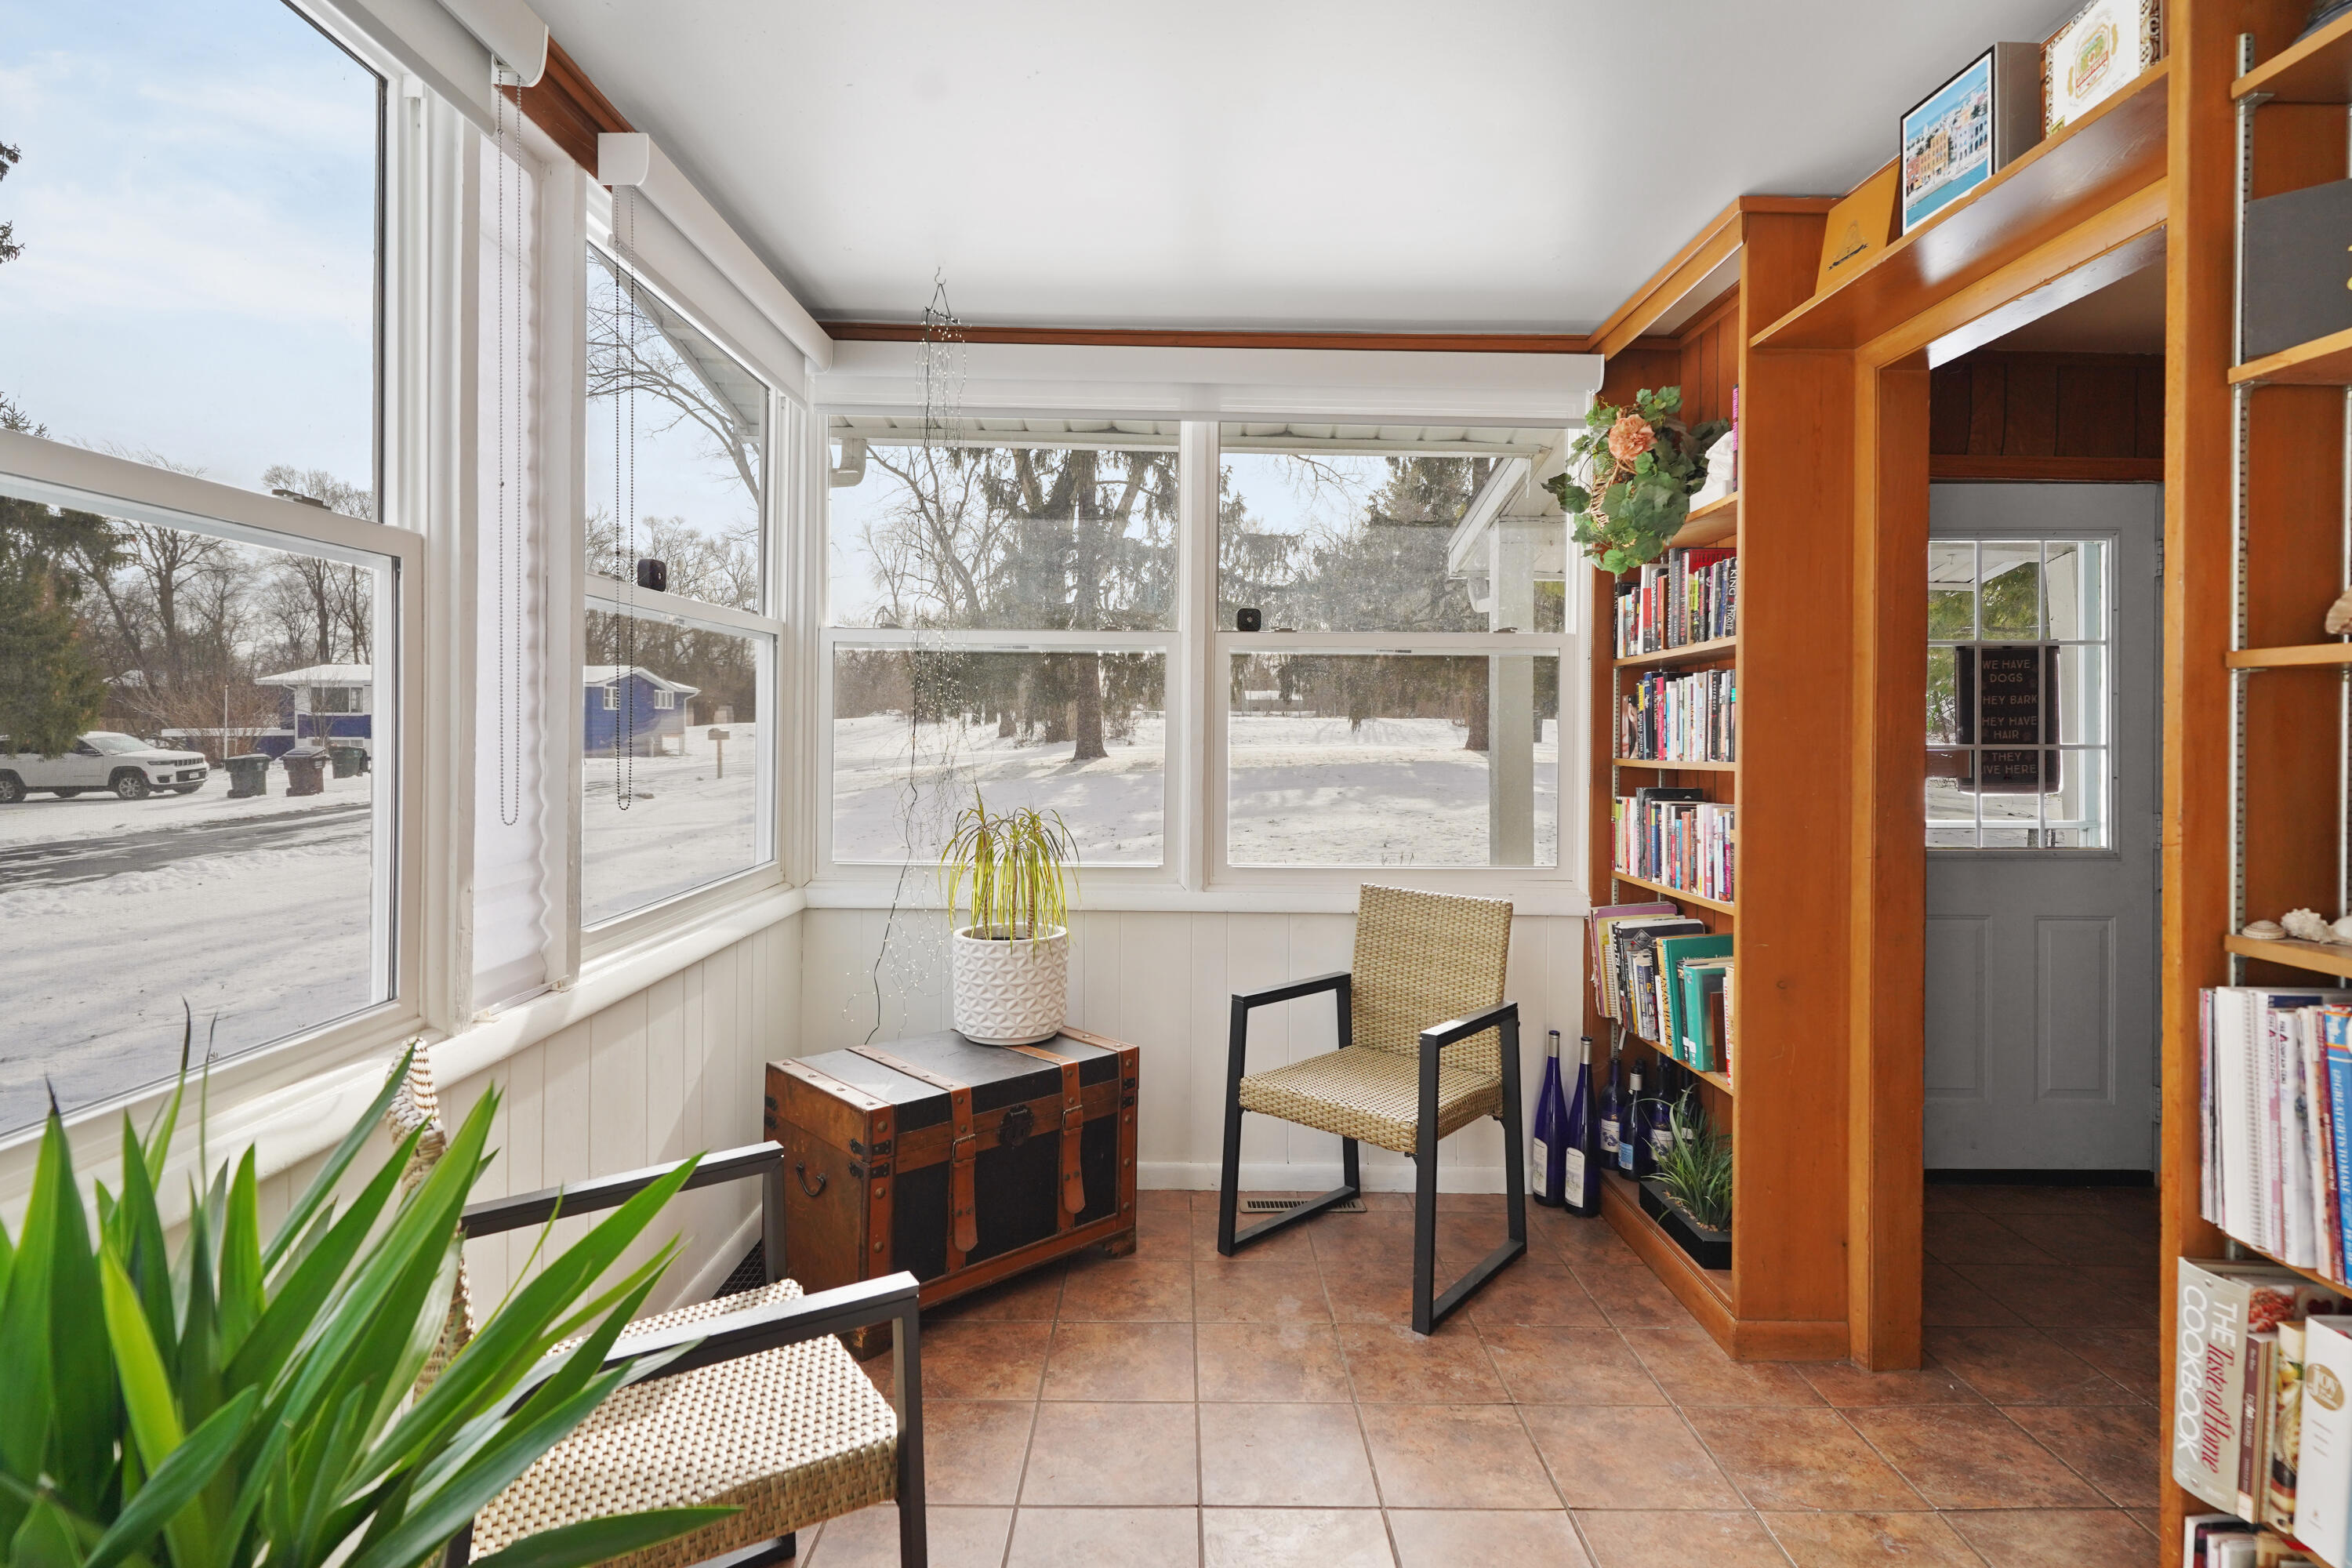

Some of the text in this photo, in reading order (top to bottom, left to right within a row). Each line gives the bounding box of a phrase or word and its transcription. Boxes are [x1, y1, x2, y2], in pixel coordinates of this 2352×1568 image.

[1729, 569, 1737, 596] KING
[1982, 659, 2031, 670] WE HAVE
[1989, 673, 2024, 683] DOGS
[1982, 695, 2038, 705] HEY BARK
[1981, 716, 2038, 727] HEY HAVE
[1994, 730, 2020, 739] HAIR
[1991, 753, 2022, 761] THEY
[1981, 764, 2038, 775] IVE HERE
[2211, 1300, 2238, 1348] THE
[2205, 1341, 2235, 1393] Taste
[2176, 1284, 2208, 1463] COOKBOOK
[2201, 1409, 2236, 1474] Home
